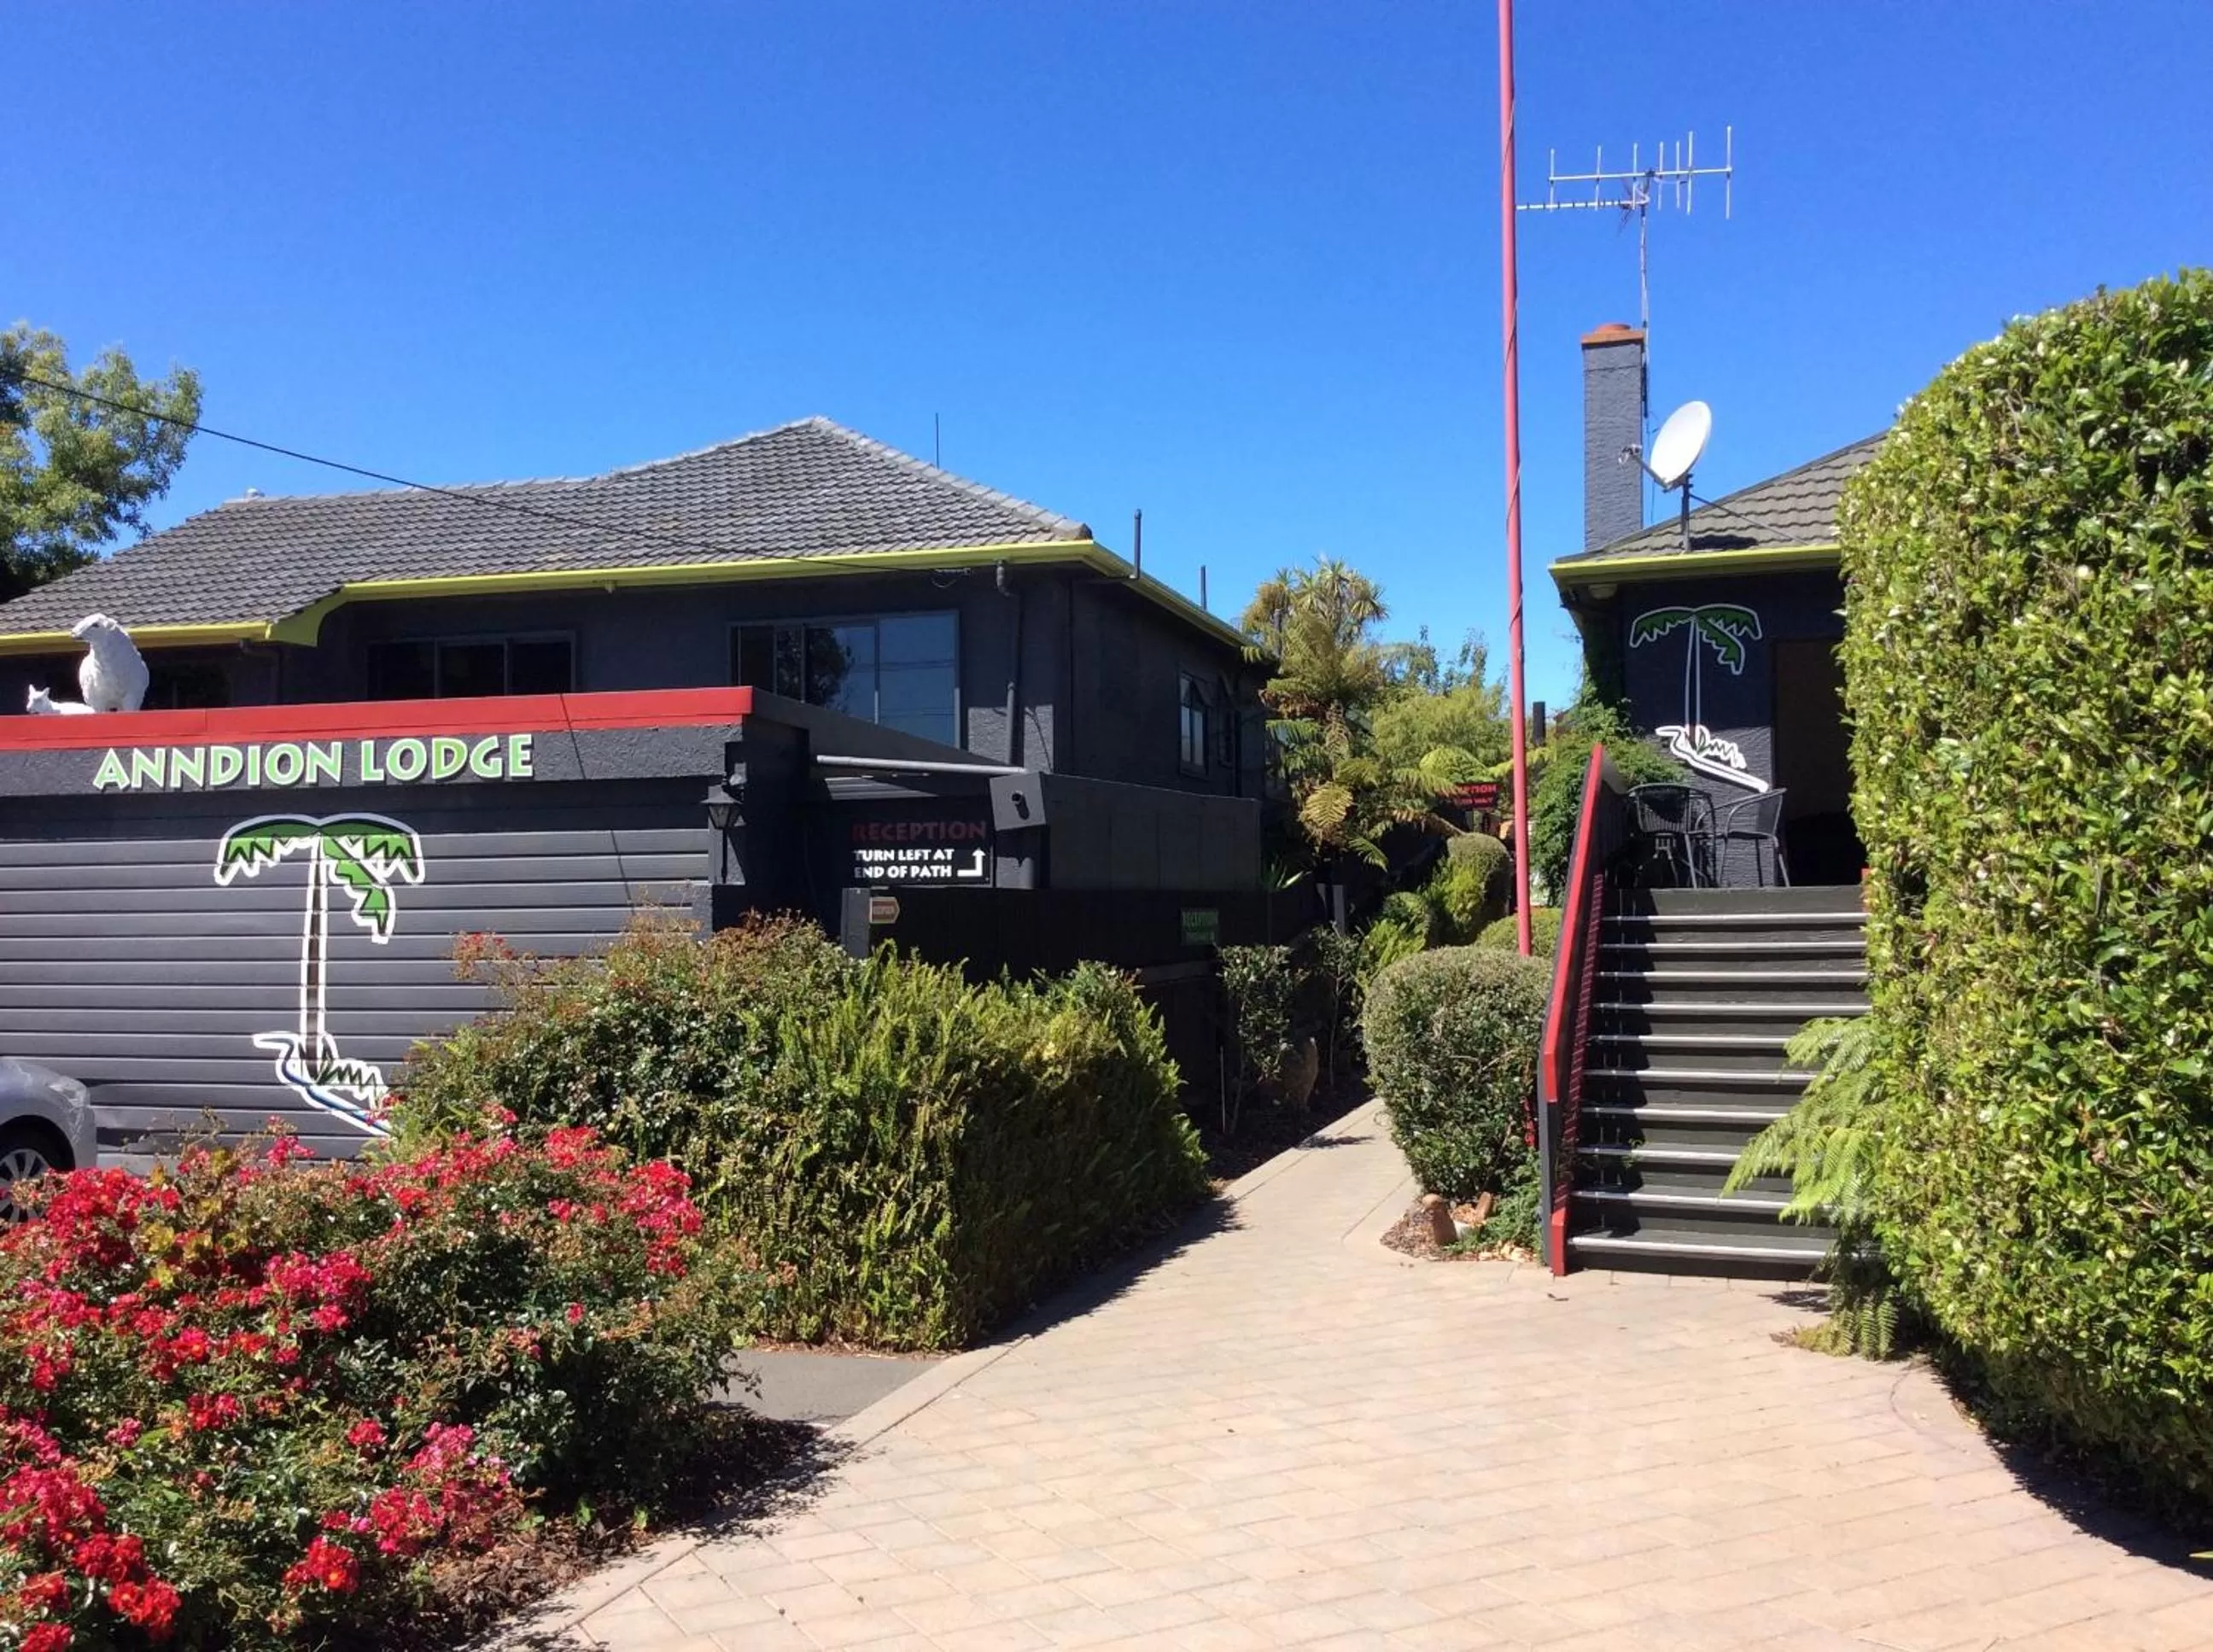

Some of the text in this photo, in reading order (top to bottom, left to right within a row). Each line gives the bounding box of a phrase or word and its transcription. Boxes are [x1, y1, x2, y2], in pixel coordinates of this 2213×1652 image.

[92, 734, 534, 791] ANNDION LODGE
[852, 821, 987, 841] RECEPTION
[852, 848, 955, 861] TURN LEFT AT
[854, 865, 953, 879] END OF PATH
